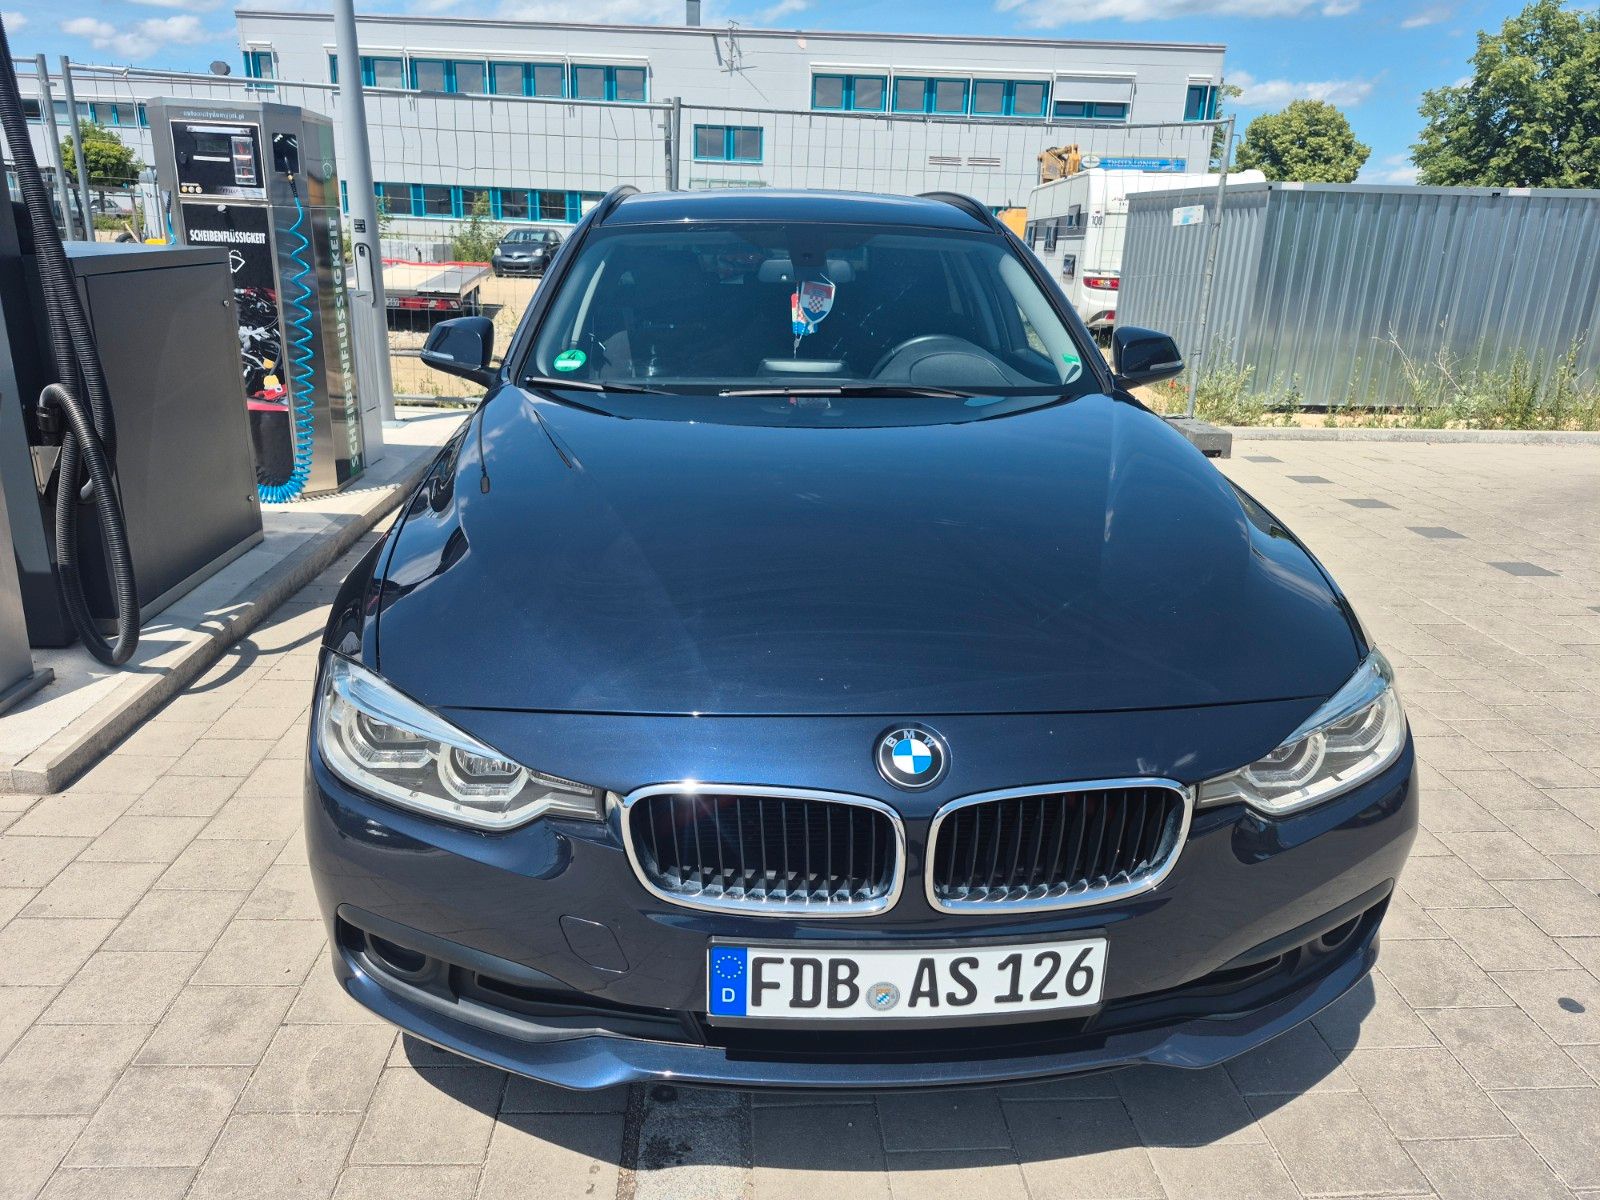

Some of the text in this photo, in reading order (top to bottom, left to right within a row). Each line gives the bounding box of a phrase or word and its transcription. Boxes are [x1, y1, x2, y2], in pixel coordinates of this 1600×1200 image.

[189, 229, 266, 244] SCHEIBENFLÜSSIGKEIT
[328, 217, 359, 468] SCHEIBENFLÜSSIGKEIT
[885, 730, 935, 748] BMW
[751, 956, 860, 1009] FDB
[907, 956, 979, 1009] AS
[994, 947, 1094, 1004] 126
[722, 988, 735, 1002] D
